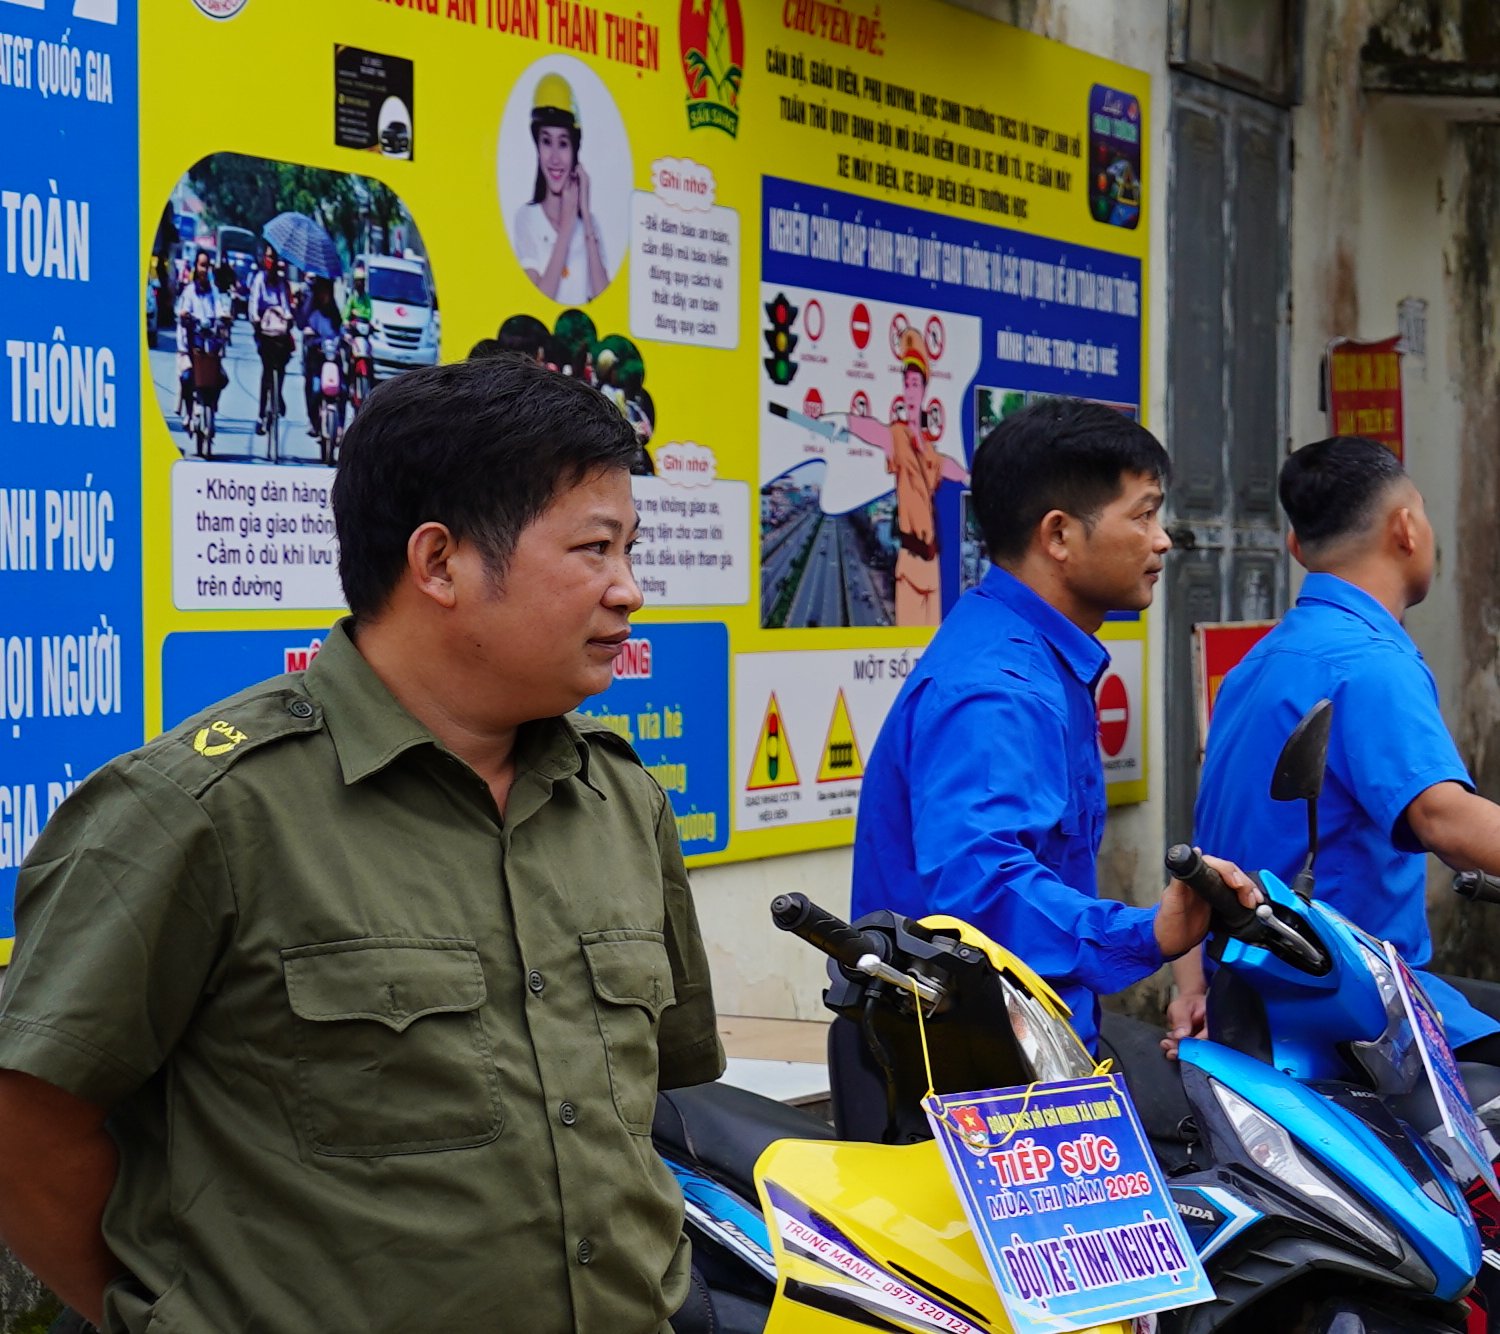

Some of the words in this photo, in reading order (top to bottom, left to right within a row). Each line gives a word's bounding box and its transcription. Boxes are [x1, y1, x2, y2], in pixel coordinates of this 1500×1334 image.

[604, 11, 660, 79] THIỆN
[855, 2, 887, 57] ĐỀ:
[37, 27, 82, 99] QUỐC
[86, 49, 113, 104] GIA
[2, 178, 90, 282] TOÀN
[6, 325, 117, 428] THÔNG
[206, 478, 256, 507] Không
[260, 480, 288, 502] dàn
[292, 481, 328, 509] hàng
[45, 472, 115, 572] PHÚC
[196, 510, 235, 533] tham
[239, 512, 262, 539] gia
[266, 512, 297, 539] giao
[301, 514, 337, 535] thôn
[206, 538, 242, 565] Cầm
[245, 543, 256, 565] ô
[259, 543, 279, 565] dù
[282, 544, 304, 565] khi
[308, 544, 333, 565] lưu
[197, 575, 228, 597] trên
[231, 574, 283, 602] đường
[41, 613, 122, 717] NGƯỜI
[853, 654, 885, 684] MỘT
[888, 648, 911, 679] SỐ
[211, 720, 249, 745] CAX
[989, 1137, 1054, 1188] TIẾP
[1057, 1132, 1121, 1178] SỨC
[986, 1187, 1031, 1222] MÙA
[1031, 1185, 1063, 1212] THI
[1063, 1174, 1107, 1208] NĂM
[1103, 1171, 1153, 1202] 2026
[785, 1219, 831, 1254] TRUNG
[829, 1244, 878, 1281] MẠNH
[882, 1281, 916, 1305] 0975
[916, 1301, 947, 1322] 520
[1001, 1232, 1053, 1310] ĐỘI
[1037, 1235, 1079, 1294] XE
[1064, 1223, 1120, 1291] TÌNH
[1105, 1209, 1190, 1286] NGUYỆN
